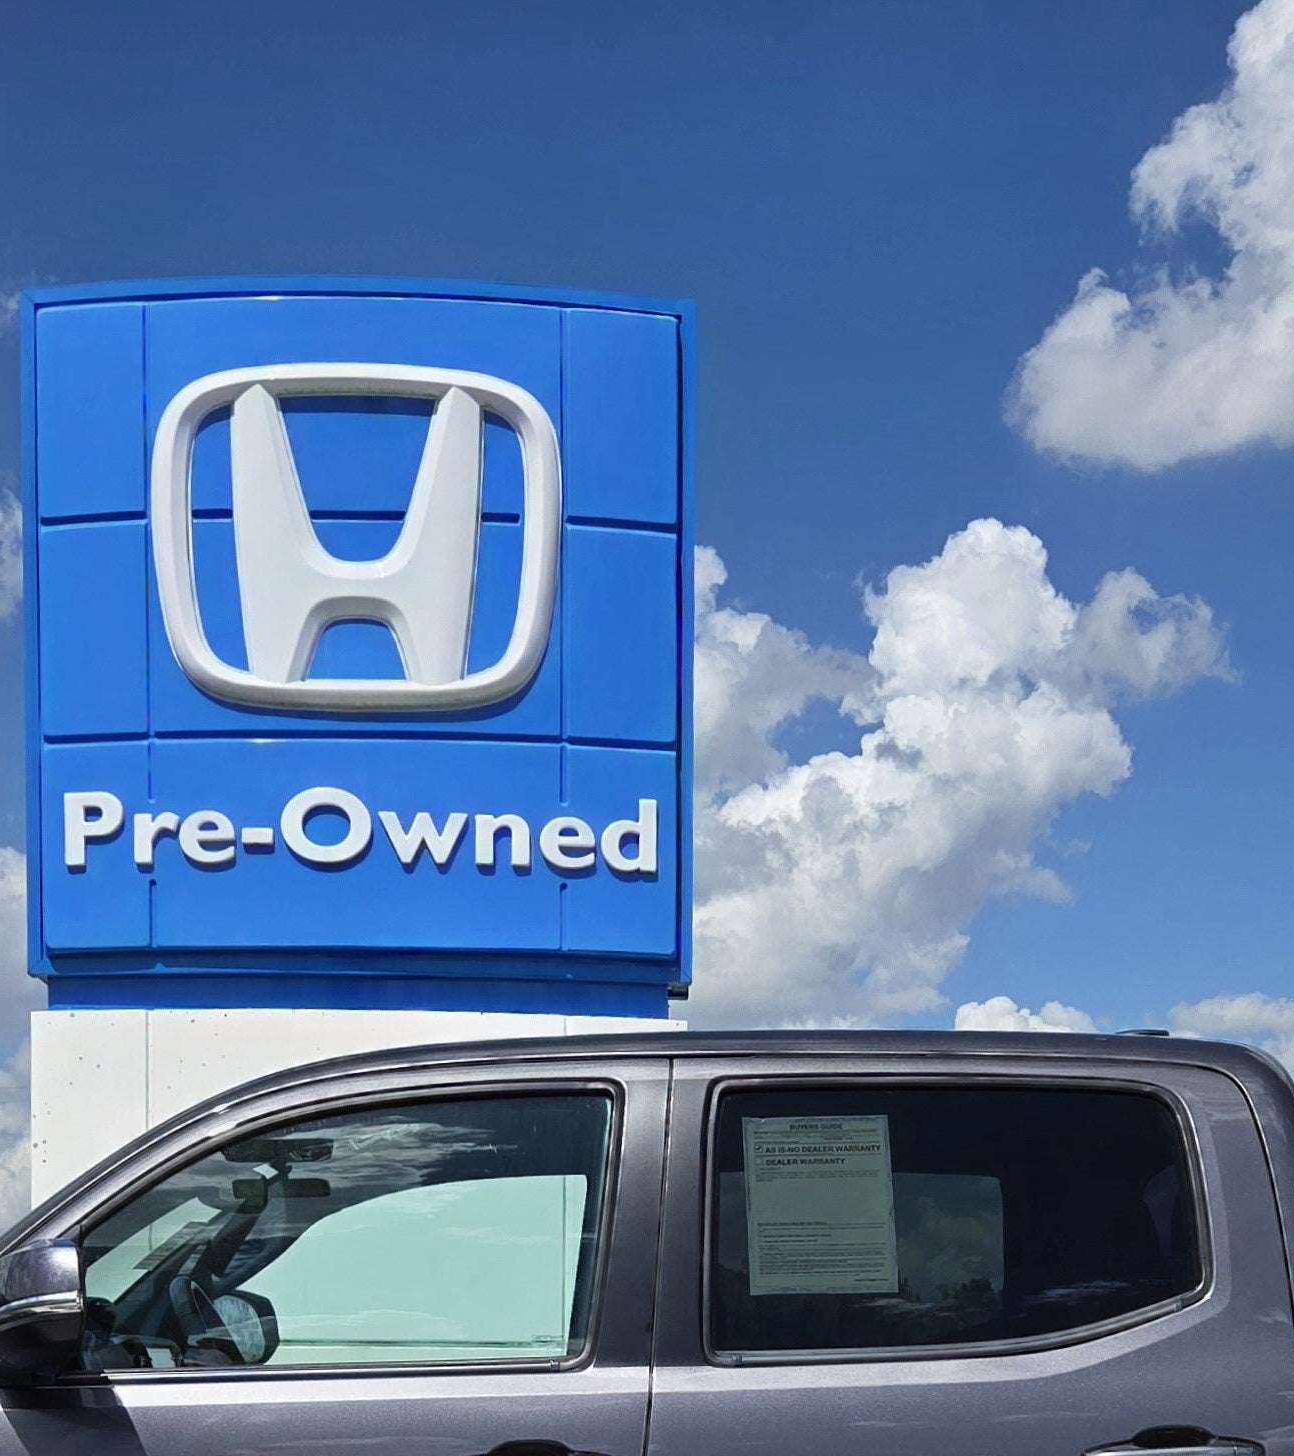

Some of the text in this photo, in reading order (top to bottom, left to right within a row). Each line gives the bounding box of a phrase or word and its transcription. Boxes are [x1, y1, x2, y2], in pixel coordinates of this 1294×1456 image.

[63, 786, 659, 875] Pre-Owned
[835, 1144, 881, 1152] WARRANTY
[765, 1157, 846, 1166] DEALER WARRANTY
